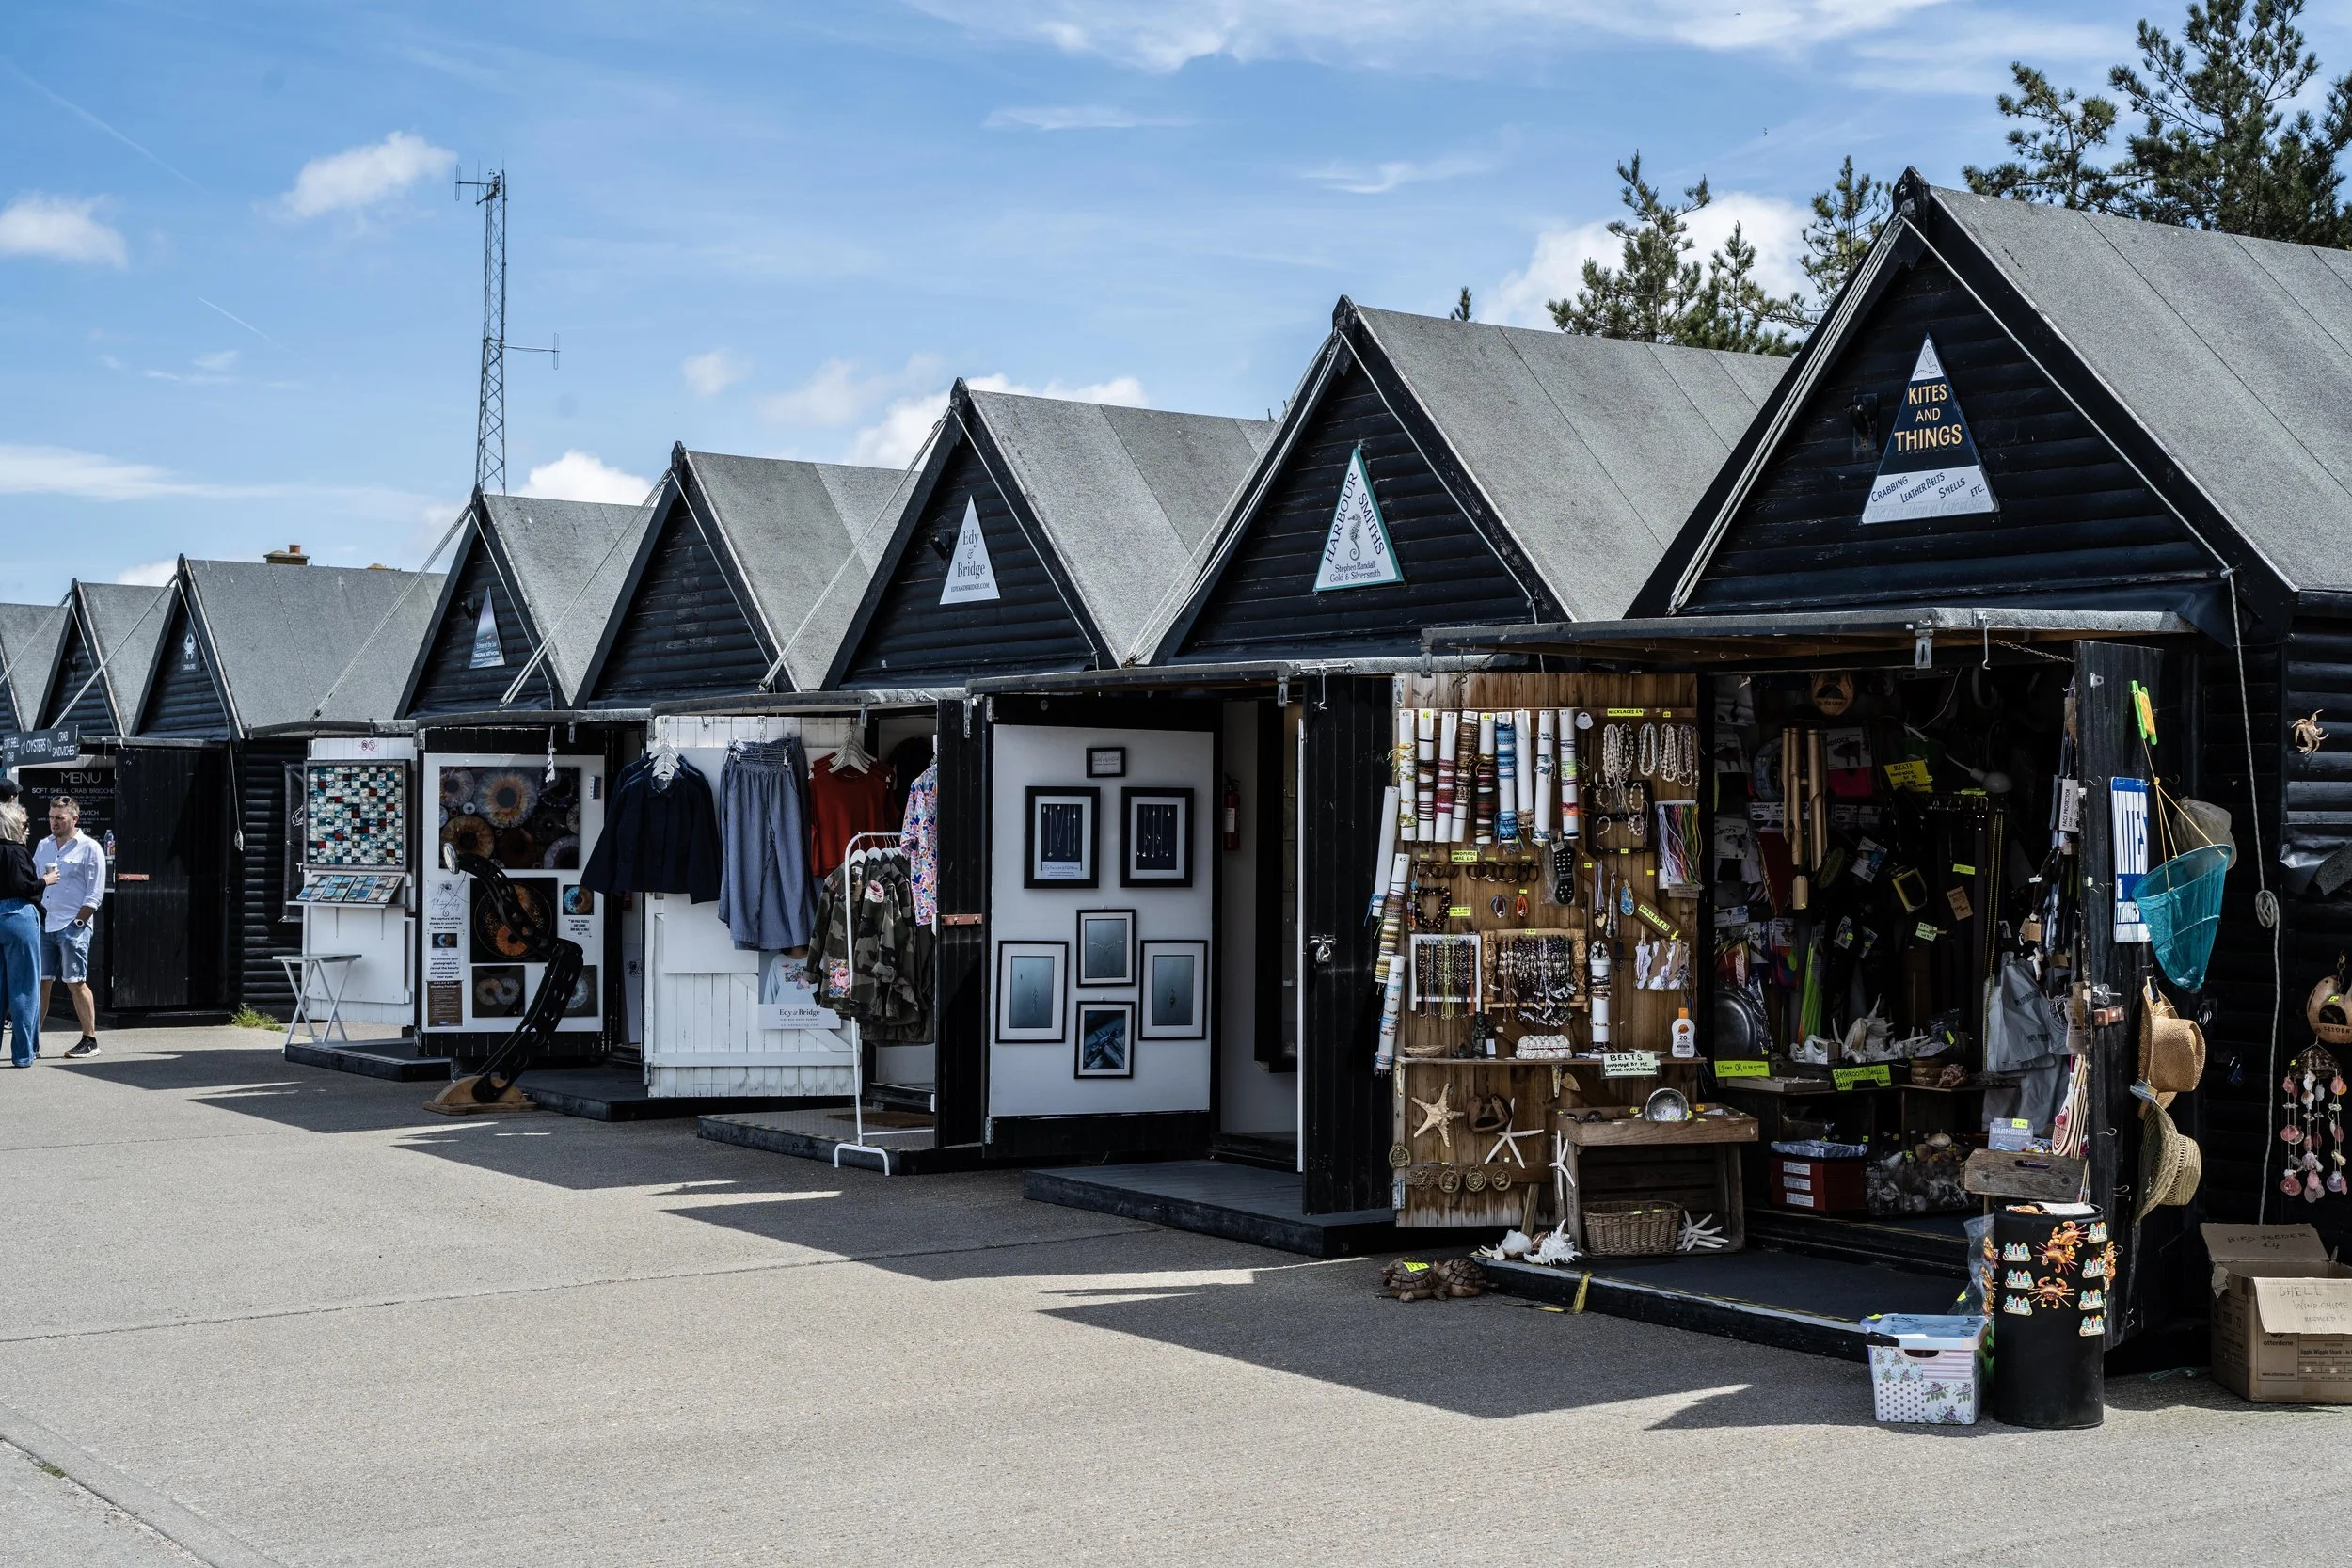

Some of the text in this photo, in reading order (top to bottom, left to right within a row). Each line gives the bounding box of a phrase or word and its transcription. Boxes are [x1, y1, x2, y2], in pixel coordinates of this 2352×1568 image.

[1909, 384, 1947, 405] KITES
[1915, 407, 1941, 422] AND
[1894, 424, 1963, 452] THINGS
[1871, 476, 1909, 502] CRABBING
[1900, 483, 1927, 503] LEATHER
[1925, 472, 1946, 489] BELTS
[1938, 478, 1966, 499] SHELLS
[1325, 472, 1359, 564] HARBOUR
[1359, 493, 1385, 555] SMITHS
[963, 529, 979, 548] Edy
[967, 548, 974, 559] &
[957, 561, 985, 579] Bridge
[1335, 561, 1375, 575] Stephen Randall
[1329, 573, 1344, 582] Gold
[1351, 569, 1381, 581] Silversmith
[58, 731, 69, 742] CRAB
[26, 738, 46, 752] OYSTERS
[52, 745, 75, 757] SANDWICHES
[60, 772, 101, 784] MENU
[1640, 905, 1661, 924] ANKLETS
[1735, 1064, 1742, 1072] OR
[1835, 1070, 1865, 1079] BATHROOM
[1992, 1128, 2030, 1136] HARMONICA
[2280, 1286, 2322, 1297] SHELL
[2293, 1300, 2317, 1309] WIND
